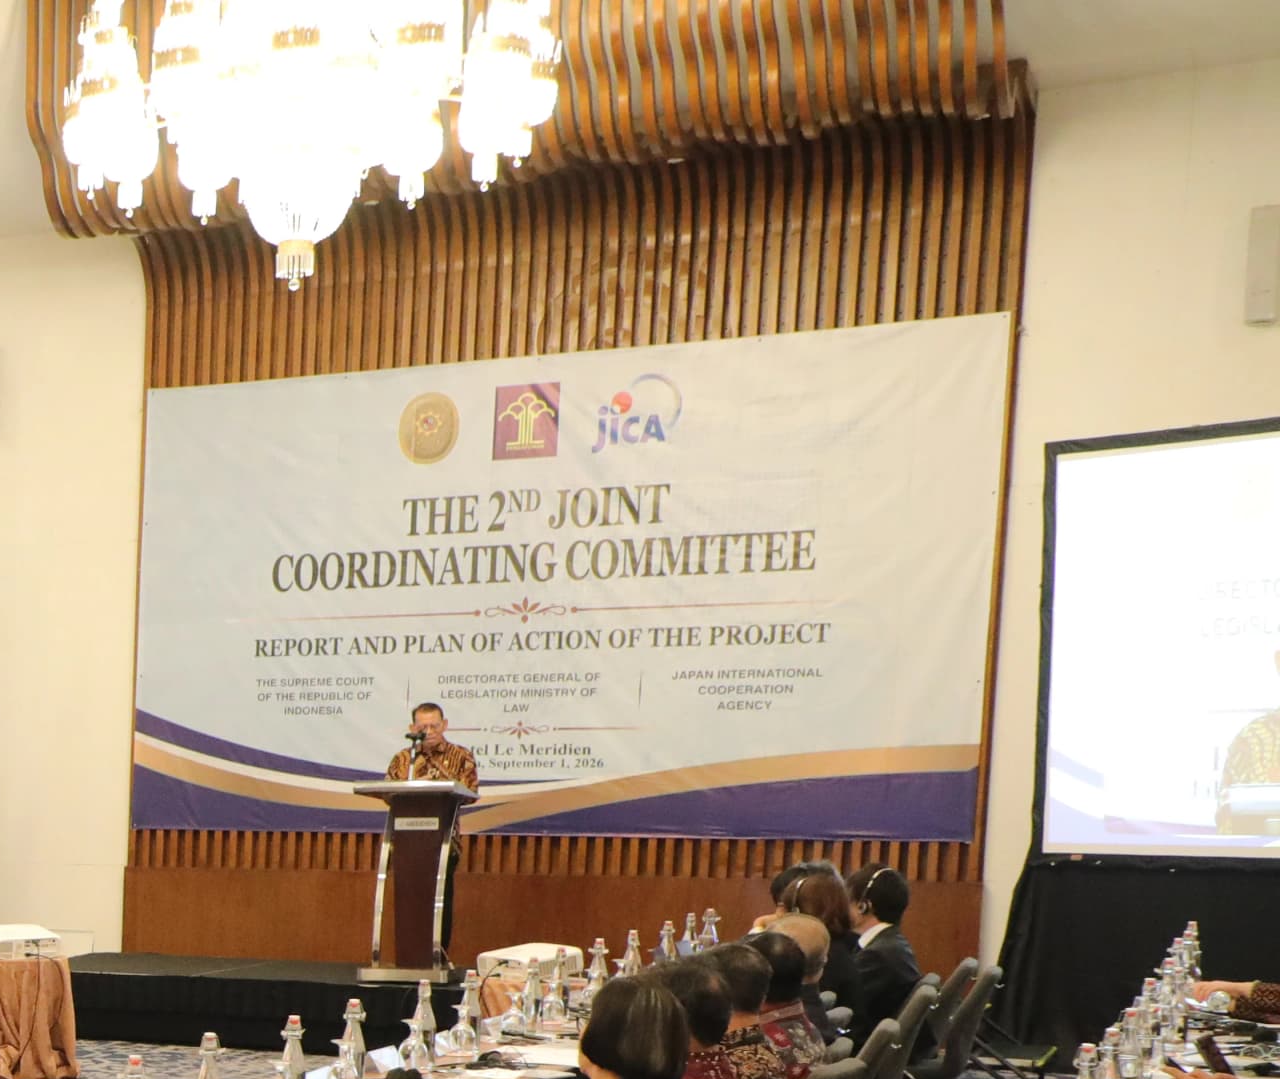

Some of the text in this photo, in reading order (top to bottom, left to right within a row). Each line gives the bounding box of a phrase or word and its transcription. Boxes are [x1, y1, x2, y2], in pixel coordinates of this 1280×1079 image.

[402, 483, 671, 537] THE 2ND JOINT
[271, 529, 817, 593] COORDINATING COMMITTEE
[254, 622, 832, 657] REPORT AND PLAN OF ACTION OF THE PROJECT
[437, 672, 601, 685] DIRECTORATE GENERAL OF
[671, 668, 823, 681] JAPAN INTERNATIONAL
[256, 676, 375, 688] THE SUPREME COURT
[440, 687, 597, 699] LEGISLATION MINISTRY OF
[697, 684, 794, 695] COOPERATION
[257, 691, 372, 702] OF THE REPUBLIC OF
[283, 706, 344, 716] INDONESIA
[503, 703, 530, 713] LAW
[717, 700, 773, 711] AGENCY
[494, 745, 514, 756] Le
[519, 743, 592, 756] Meridien
[488, 758, 557, 770] September
[574, 758, 604, 769] 2026
